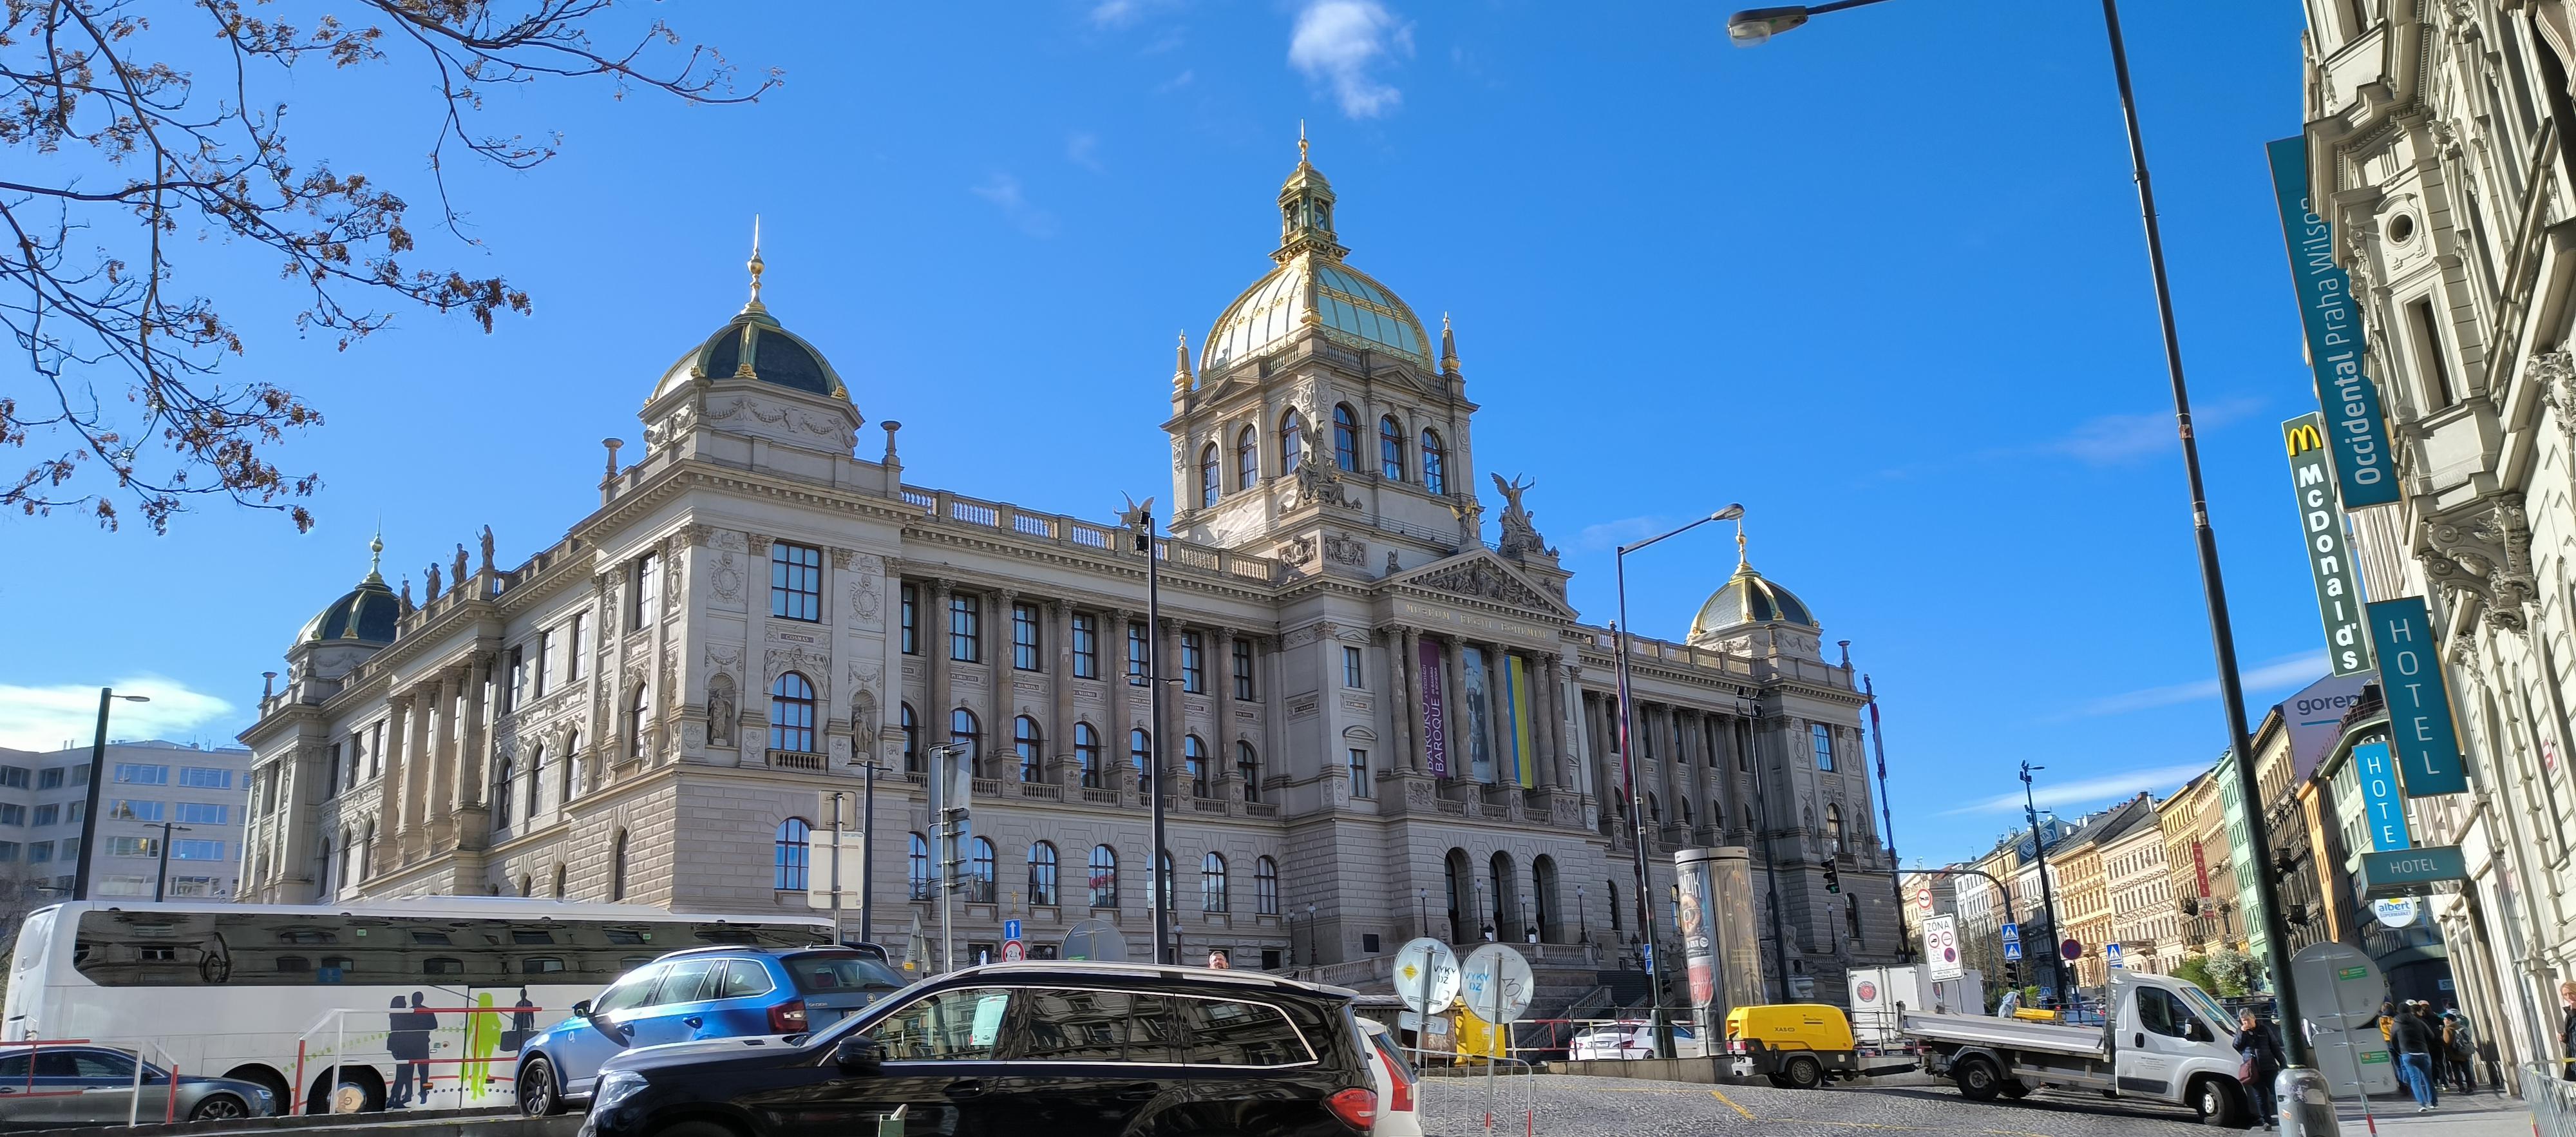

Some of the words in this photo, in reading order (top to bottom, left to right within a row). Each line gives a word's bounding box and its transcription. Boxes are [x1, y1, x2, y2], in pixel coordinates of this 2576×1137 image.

[2316, 278, 2350, 346] Praha
[2327, 351, 2381, 485] Occidental
[2299, 463, 2358, 670] McDonald's
[2389, 618, 2440, 774] HOTEL
[1431, 698, 1444, 772] BAROQUE
[2367, 756, 2396, 843] HOTE
[2196, 853, 2207, 893] HOTEL
[2390, 859, 2438, 874] HOTEL
[1927, 921, 1951, 932] ZÓNA
[2378, 901, 2410, 912] albert
